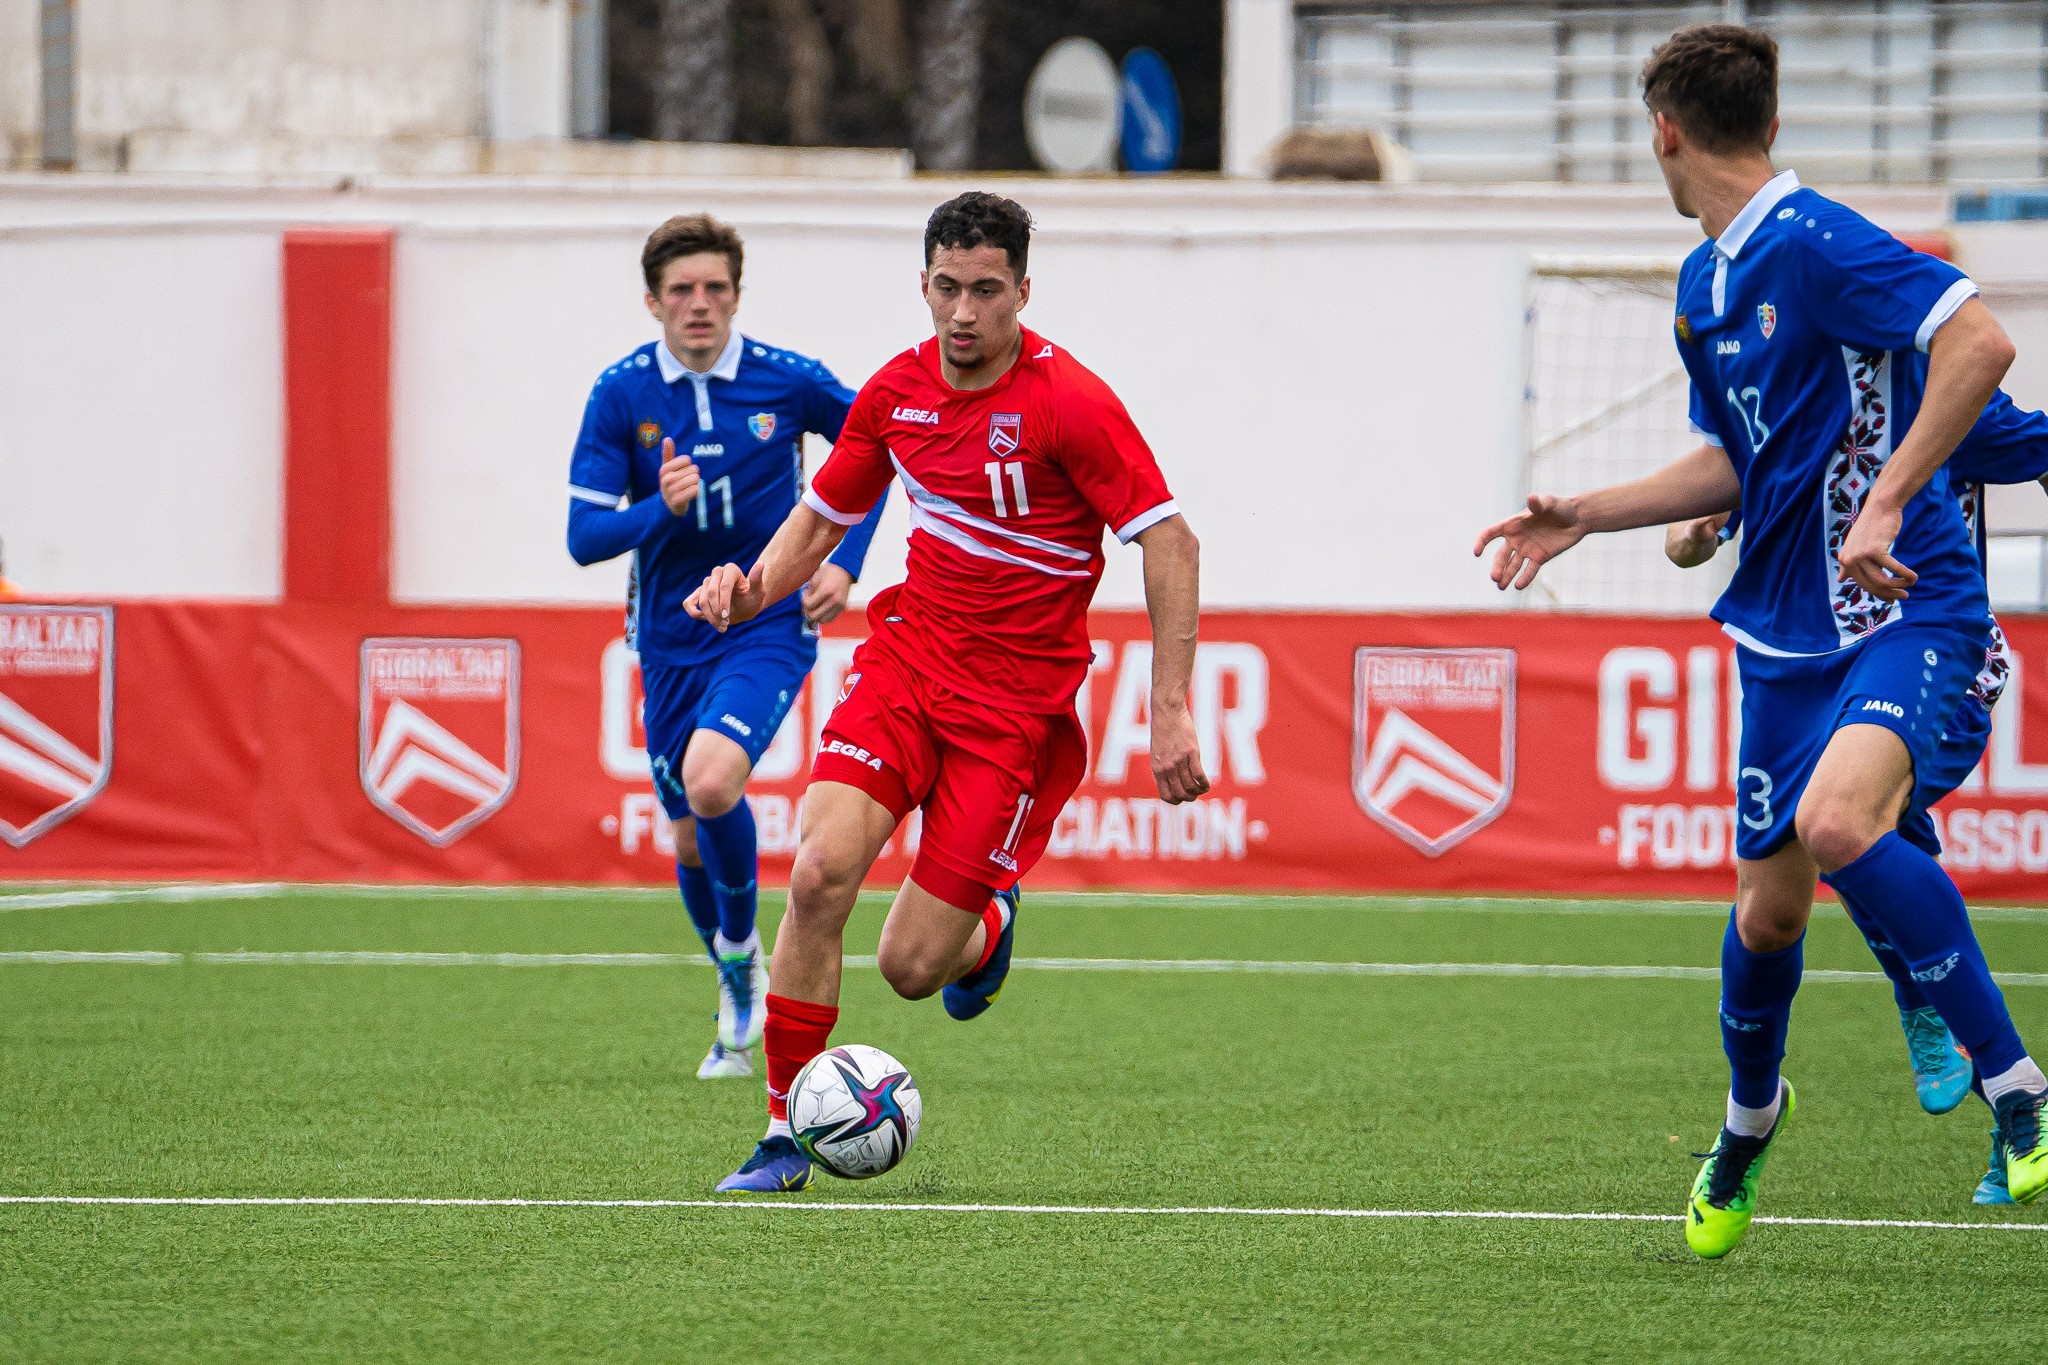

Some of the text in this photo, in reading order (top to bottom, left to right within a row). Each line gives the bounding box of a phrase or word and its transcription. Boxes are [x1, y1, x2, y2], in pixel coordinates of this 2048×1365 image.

[1716, 340, 1741, 355] JAKO
[891, 406, 940, 425] LEGEA
[1727, 386, 1770, 454] 13
[984, 461, 1031, 518] 11
[1861, 700, 1905, 719] JAKO
[818, 739, 884, 772] LEGEA
[1740, 766, 1775, 831] 3
